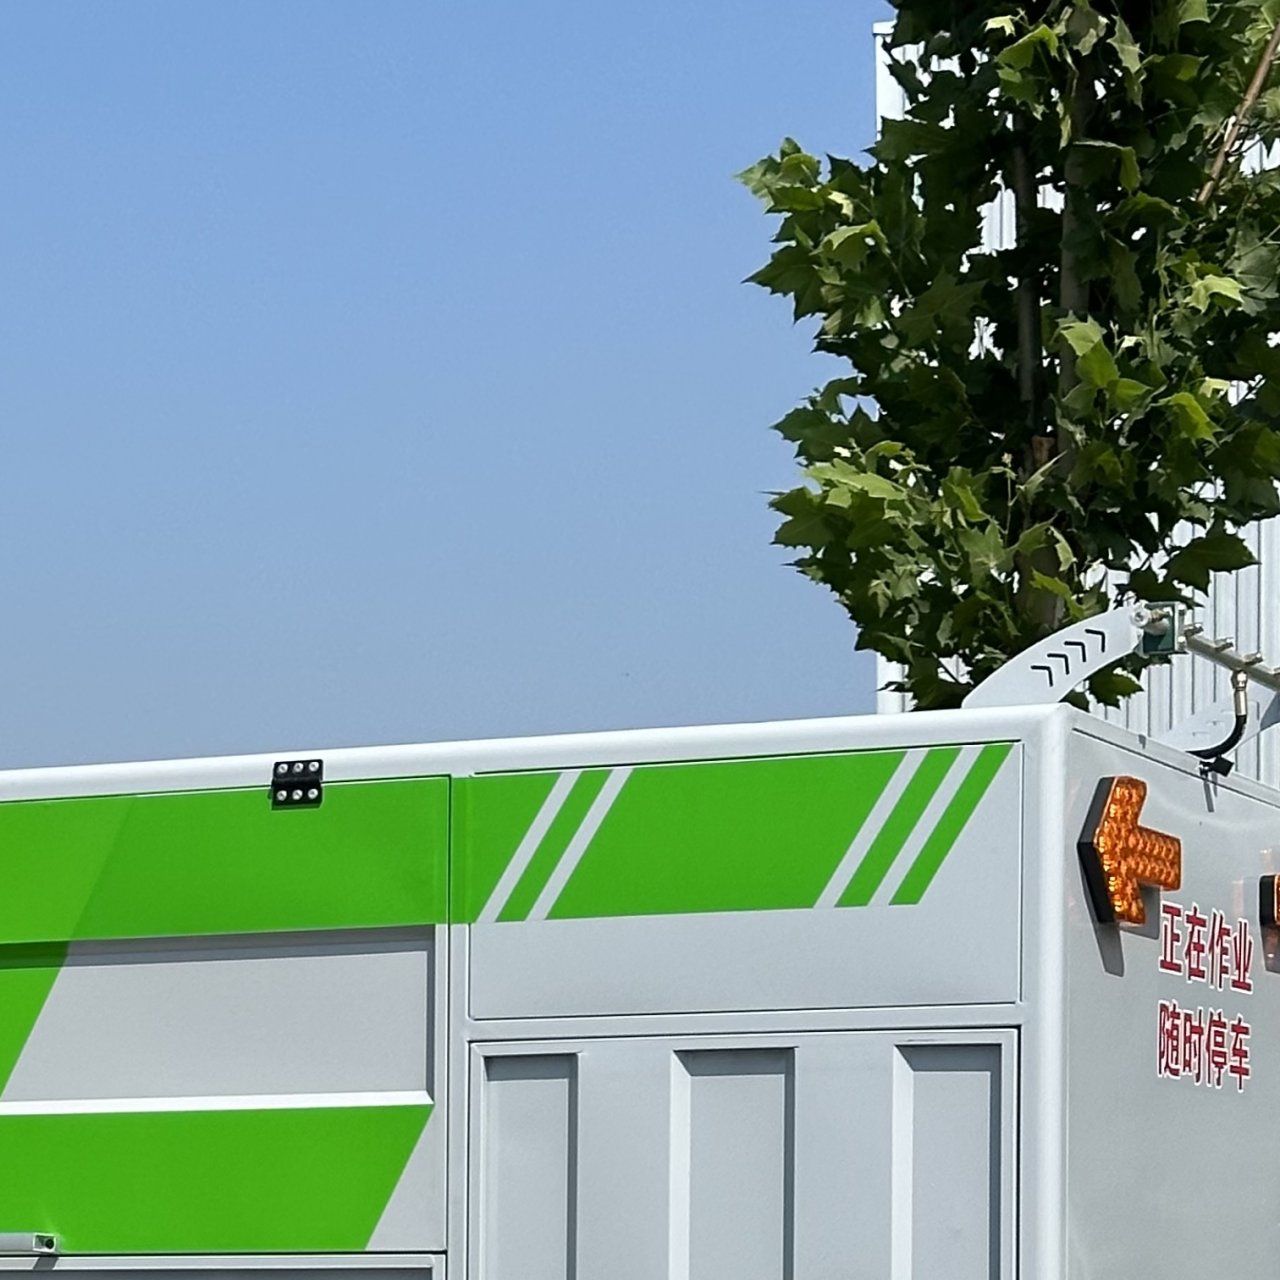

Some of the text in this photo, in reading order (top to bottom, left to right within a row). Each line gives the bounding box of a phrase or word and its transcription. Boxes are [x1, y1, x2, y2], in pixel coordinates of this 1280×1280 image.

[1158, 901, 1254, 994] 正在作业
[1157, 999, 1252, 1092] 随时停车
